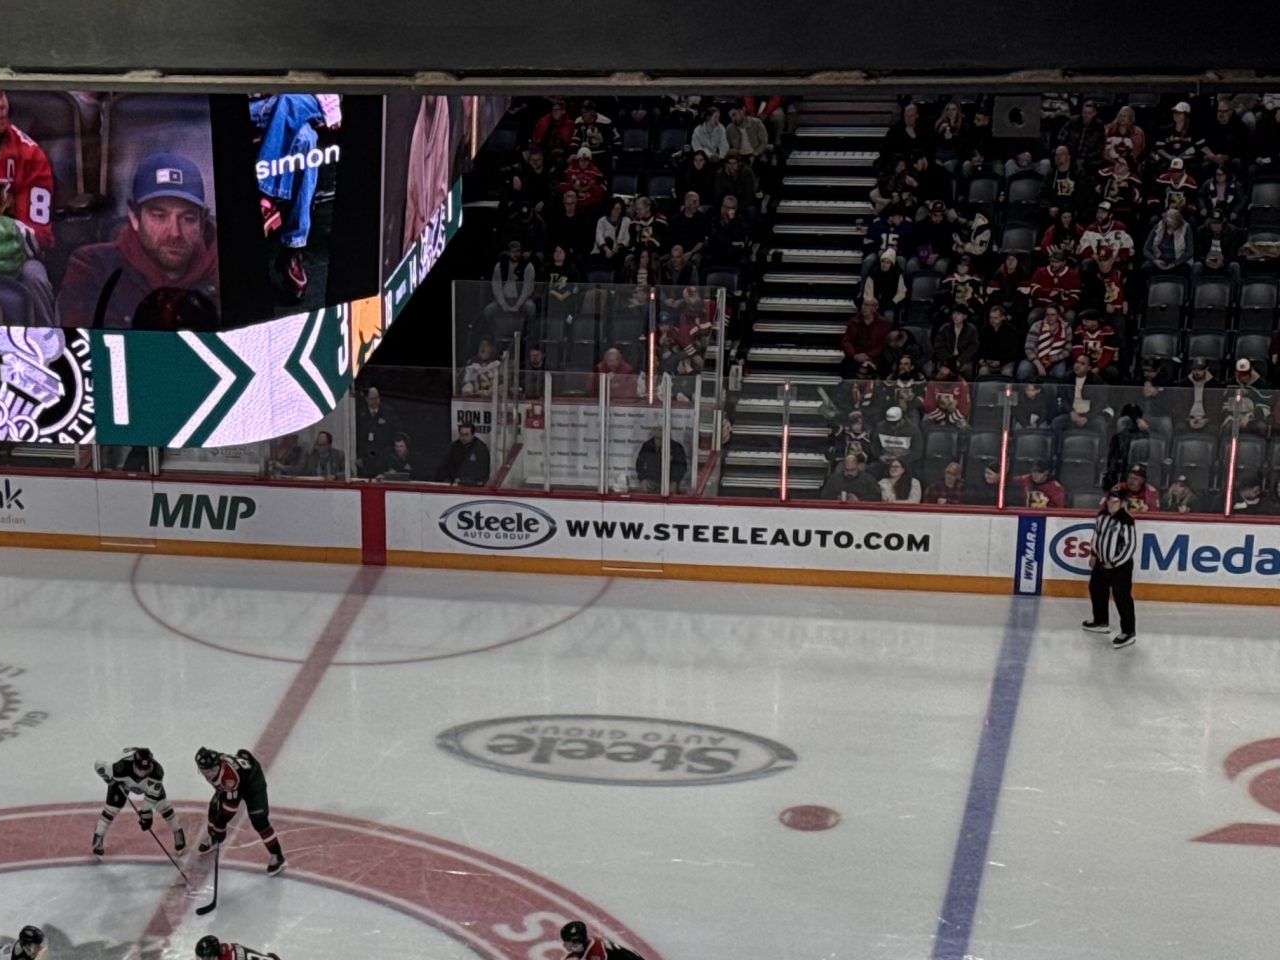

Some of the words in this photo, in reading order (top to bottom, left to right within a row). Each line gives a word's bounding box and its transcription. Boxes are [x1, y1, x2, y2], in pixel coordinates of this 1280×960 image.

[255, 144, 341, 180] simon
[29, 187, 51, 224] 8
[336, 302, 349, 376] 3
[102, 334, 130, 425] 1
[149, 492, 256, 531] MNP
[456, 510, 540, 533] Steele
[463, 531, 491, 539] AUTO
[494, 532, 531, 541] GROUP
[565, 518, 931, 553] WWW.STEELEAUTO.COM
[1023, 521, 1038, 581] WINMAR.ca
[1062, 536, 1093, 559] Es
[1140, 532, 1280, 576] Meda
[521, 724, 632, 742] GROUP
[640, 731, 727, 747] AUTO
[486, 732, 741, 775] Steele
